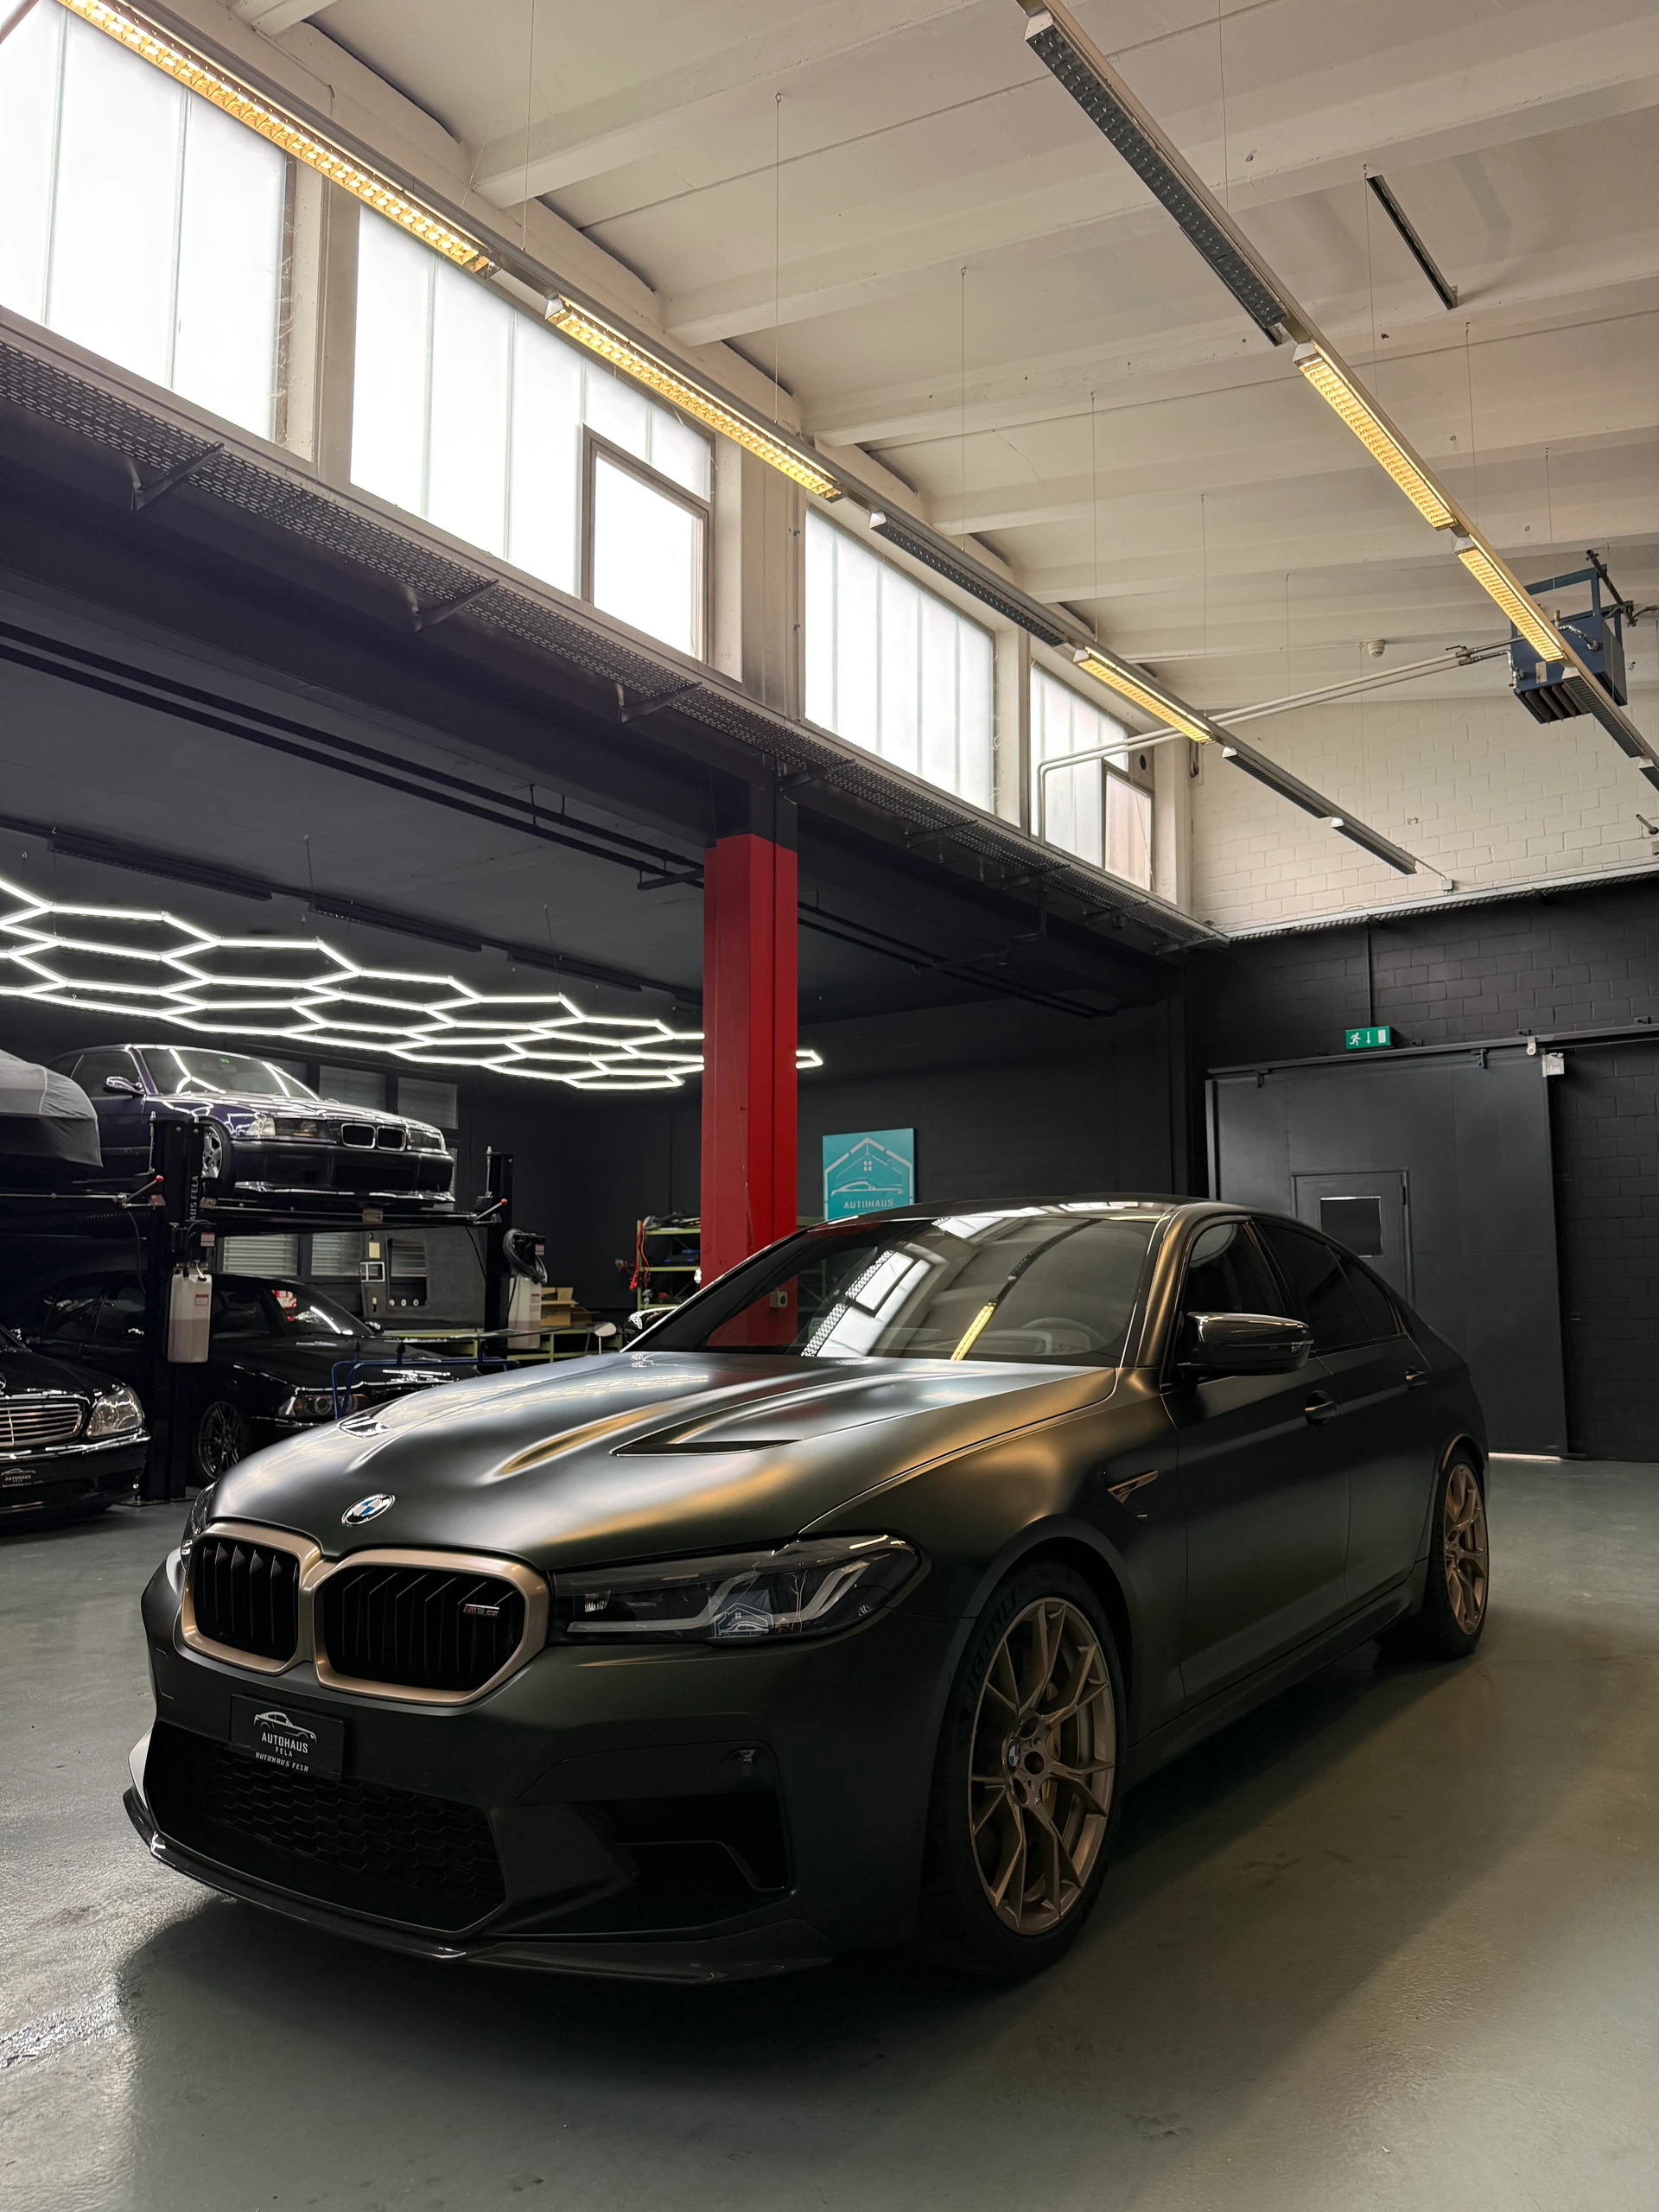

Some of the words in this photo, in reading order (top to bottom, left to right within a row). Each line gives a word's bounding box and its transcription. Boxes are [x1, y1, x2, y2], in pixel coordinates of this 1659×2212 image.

[190, 1174, 199, 1200] FELA
[843, 1198, 893, 1210] AUTOHAUS
[261, 1732, 308, 1754] AUTOHAUS
[275, 1746, 293, 1758] FELA
[255, 1751, 290, 1767] AUTOHAUS
[292, 1762, 309, 1772] FELA
